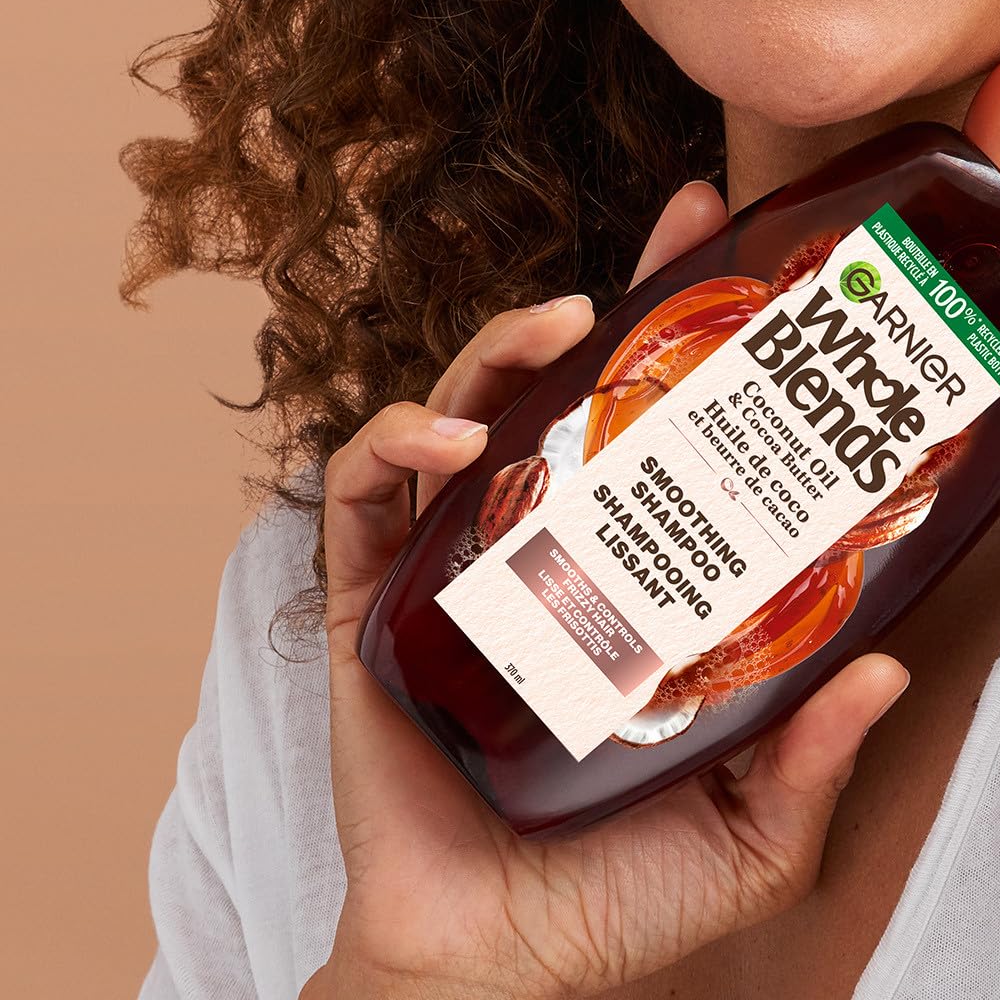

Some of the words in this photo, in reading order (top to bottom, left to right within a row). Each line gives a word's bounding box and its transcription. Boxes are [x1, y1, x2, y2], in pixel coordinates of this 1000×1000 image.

[871, 221, 903, 257] PLASTIQUE
[896, 251, 926, 282] RECYCLÉ
[901, 236, 933, 270] BOUTEILLE
[925, 265, 939, 279] EN
[794, 285, 926, 443] Whole
[842, 268, 966, 407] GARNIER
[966, 332, 993, 361] PLASTIC
[728, 392, 743, 409] &
[741, 407, 782, 456] Cocoa
[779, 451, 824, 501] Butter
[740, 308, 902, 494] Blends
[742, 380, 812, 461] Coconut
[809, 458, 840, 491] Oil
[687, 410, 705, 428] et
[701, 422, 746, 477] beurre
[744, 476, 763, 497] de
[761, 496, 800, 538] cacao
[702, 398, 750, 454] Huile
[748, 454, 771, 479] de
[769, 479, 810, 523] coco
[593, 484, 713, 621] SHAMPOOING
[595, 522, 676, 609] LISSANT
[630, 481, 721, 582] SHAMPOO
[640, 456, 747, 579] SMOOTHING
[538, 569, 565, 599] LISSE
[560, 595, 577, 610] ET
[572, 609, 620, 661] CONTRÔLE
[541, 588, 561, 609] LES
[556, 605, 603, 656] FRISOTTIS
[549, 548, 593, 597] SMOOTHS
[589, 595, 599, 605] &
[596, 602, 643, 654] CONTROLS
[562, 577, 596, 613] FRIZZY
[591, 611, 616, 638] HAIR
[504, 662, 519, 677] 370
[513, 674, 526, 685] ml
